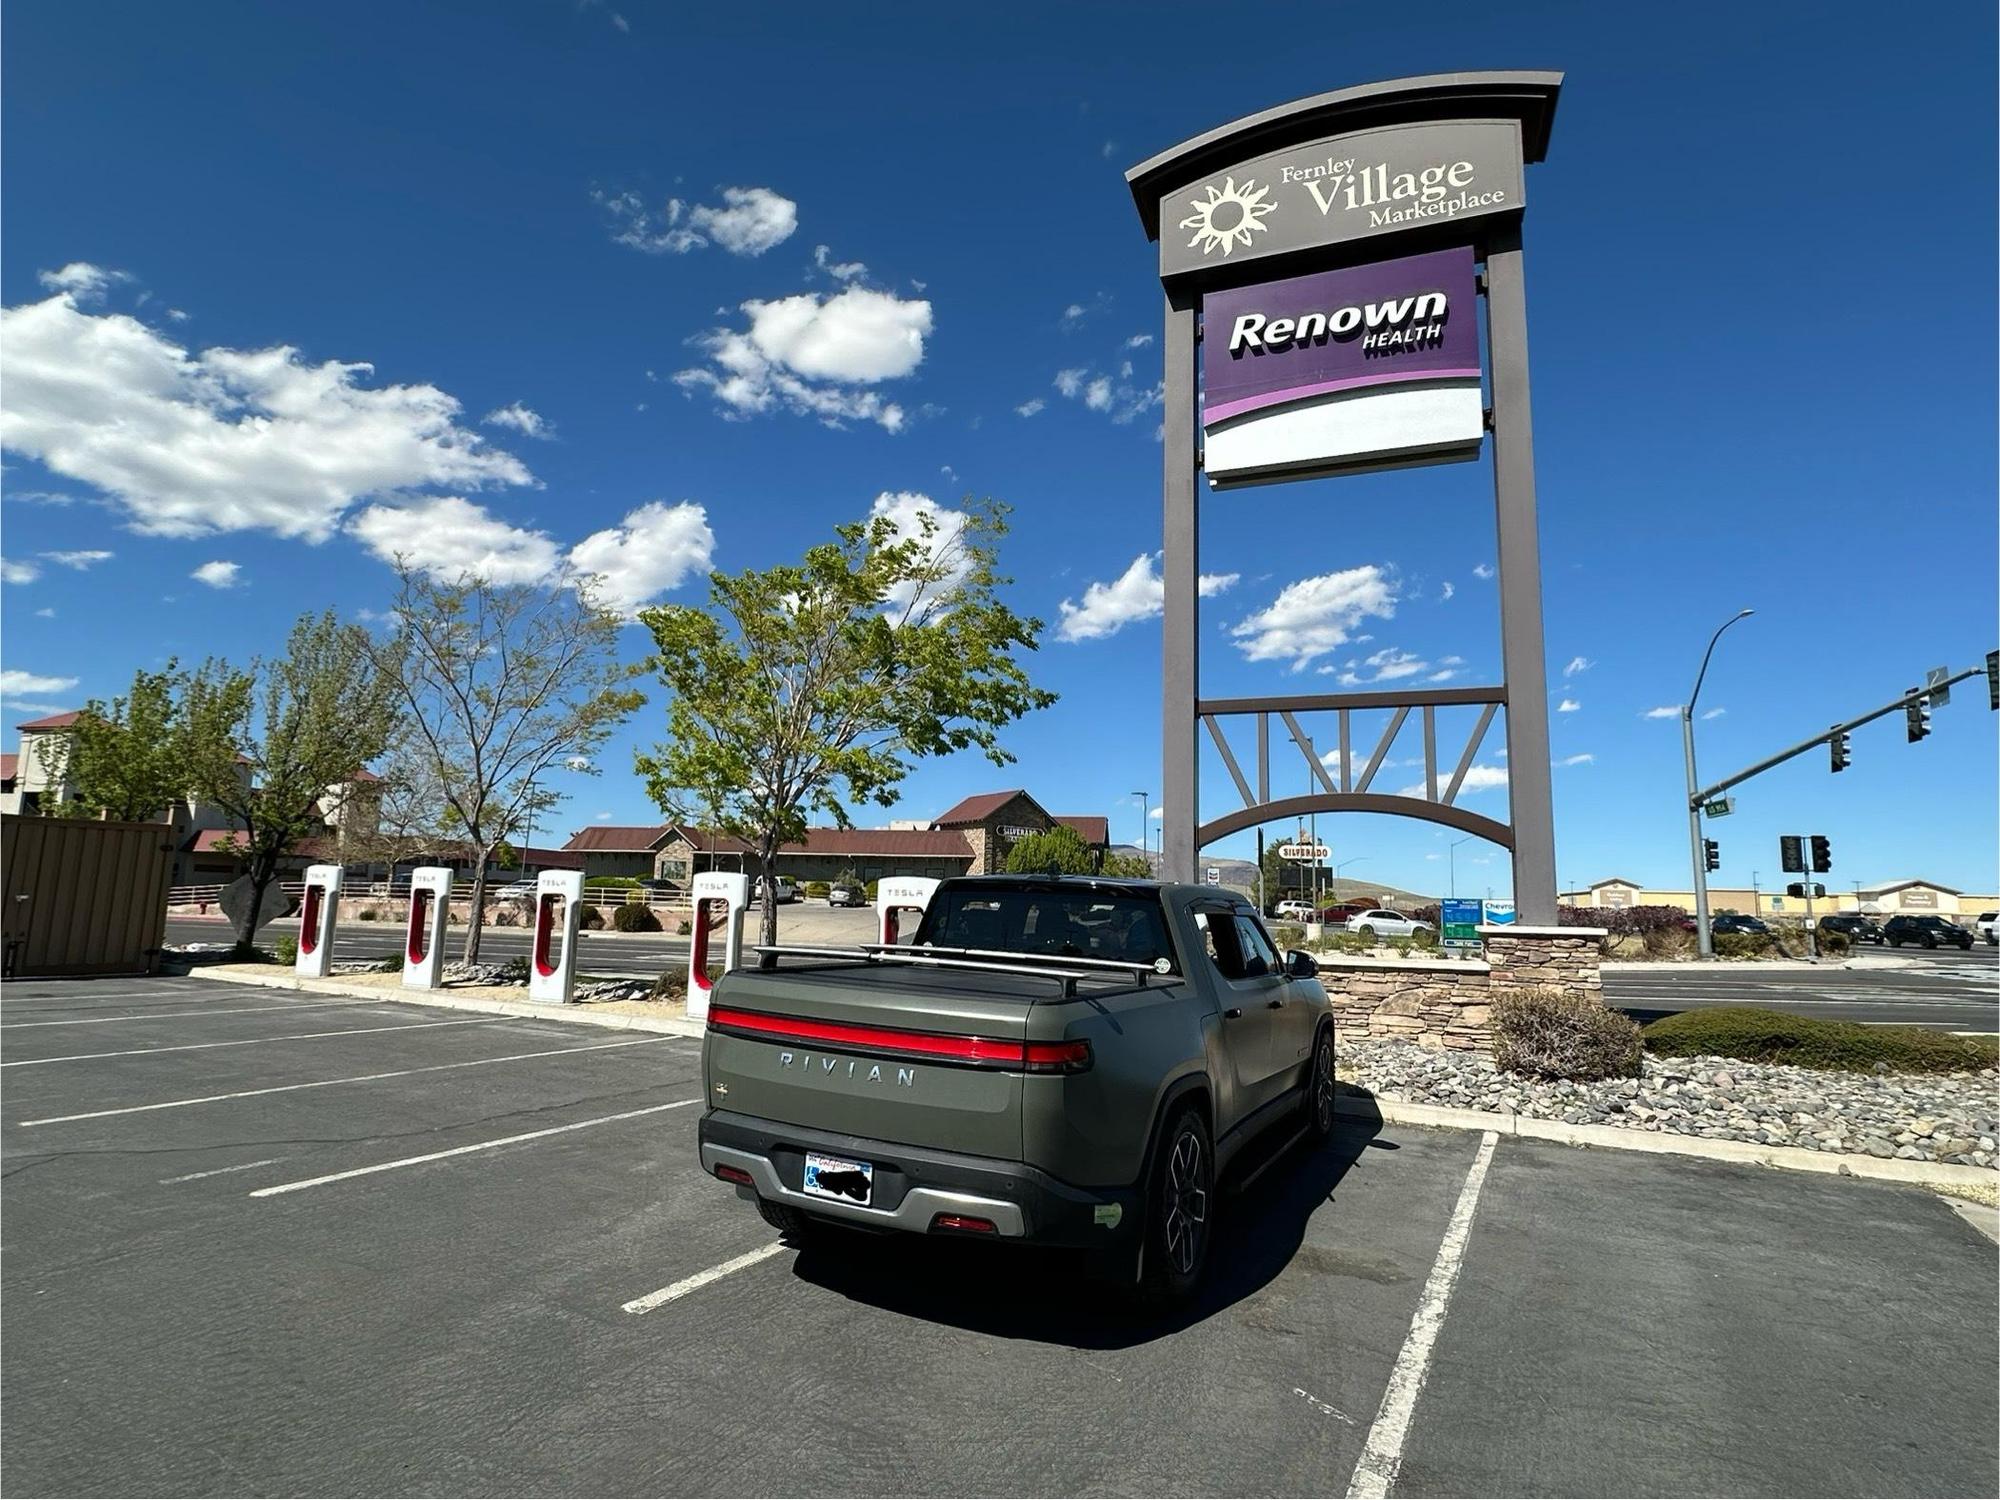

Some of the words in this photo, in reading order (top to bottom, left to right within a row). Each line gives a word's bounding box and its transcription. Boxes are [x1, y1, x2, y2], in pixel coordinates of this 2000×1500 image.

[1280, 158, 1355, 184] Fernley
[1302, 161, 1474, 215] Village
[1369, 190, 1505, 228] Marketplace
[1229, 292, 1447, 350] Renown
[1362, 324, 1441, 350] HEALTH
[1283, 848, 1328, 858] SILVERADO
[887, 889, 924, 897] TESLA
[1485, 902, 1514, 911] Chevro
[780, 1052, 915, 1087] RIVIAN
